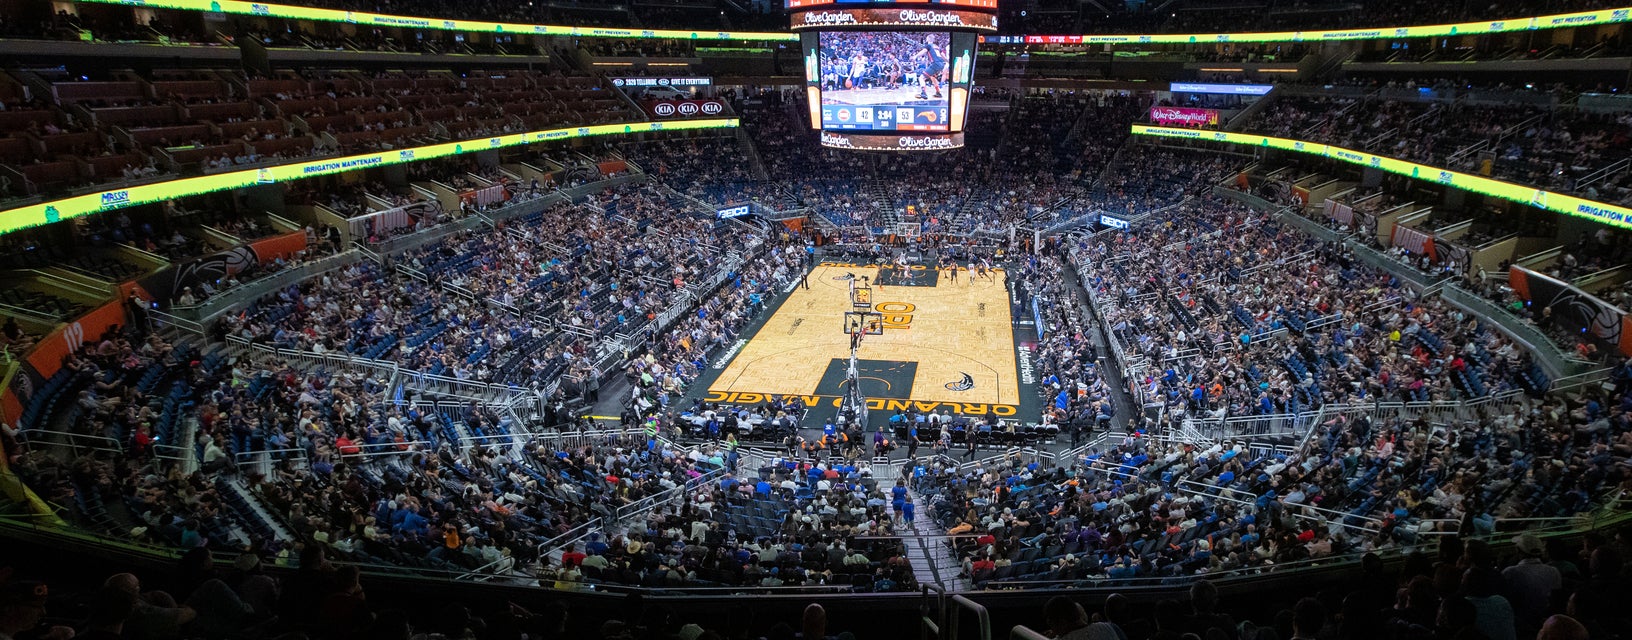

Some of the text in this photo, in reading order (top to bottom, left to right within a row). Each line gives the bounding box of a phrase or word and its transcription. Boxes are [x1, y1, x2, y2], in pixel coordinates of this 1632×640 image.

[822, 11, 857, 25] Garden
[900, 10, 963, 25] Olive Garden
[658, 105, 672, 113] KIA
[681, 105, 695, 113] KIA
[704, 104, 719, 112] KIA
[877, 110, 893, 120] 3:04
[901, 111, 910, 121] 53
[898, 136, 953, 149] Olive Garden
[304, 156, 382, 173] IRRIGATION MAINTENANCE
[101, 190, 129, 202] MASSEY
[719, 205, 748, 219] GEICO
[1577, 204, 1623, 222] IRRIGATION
